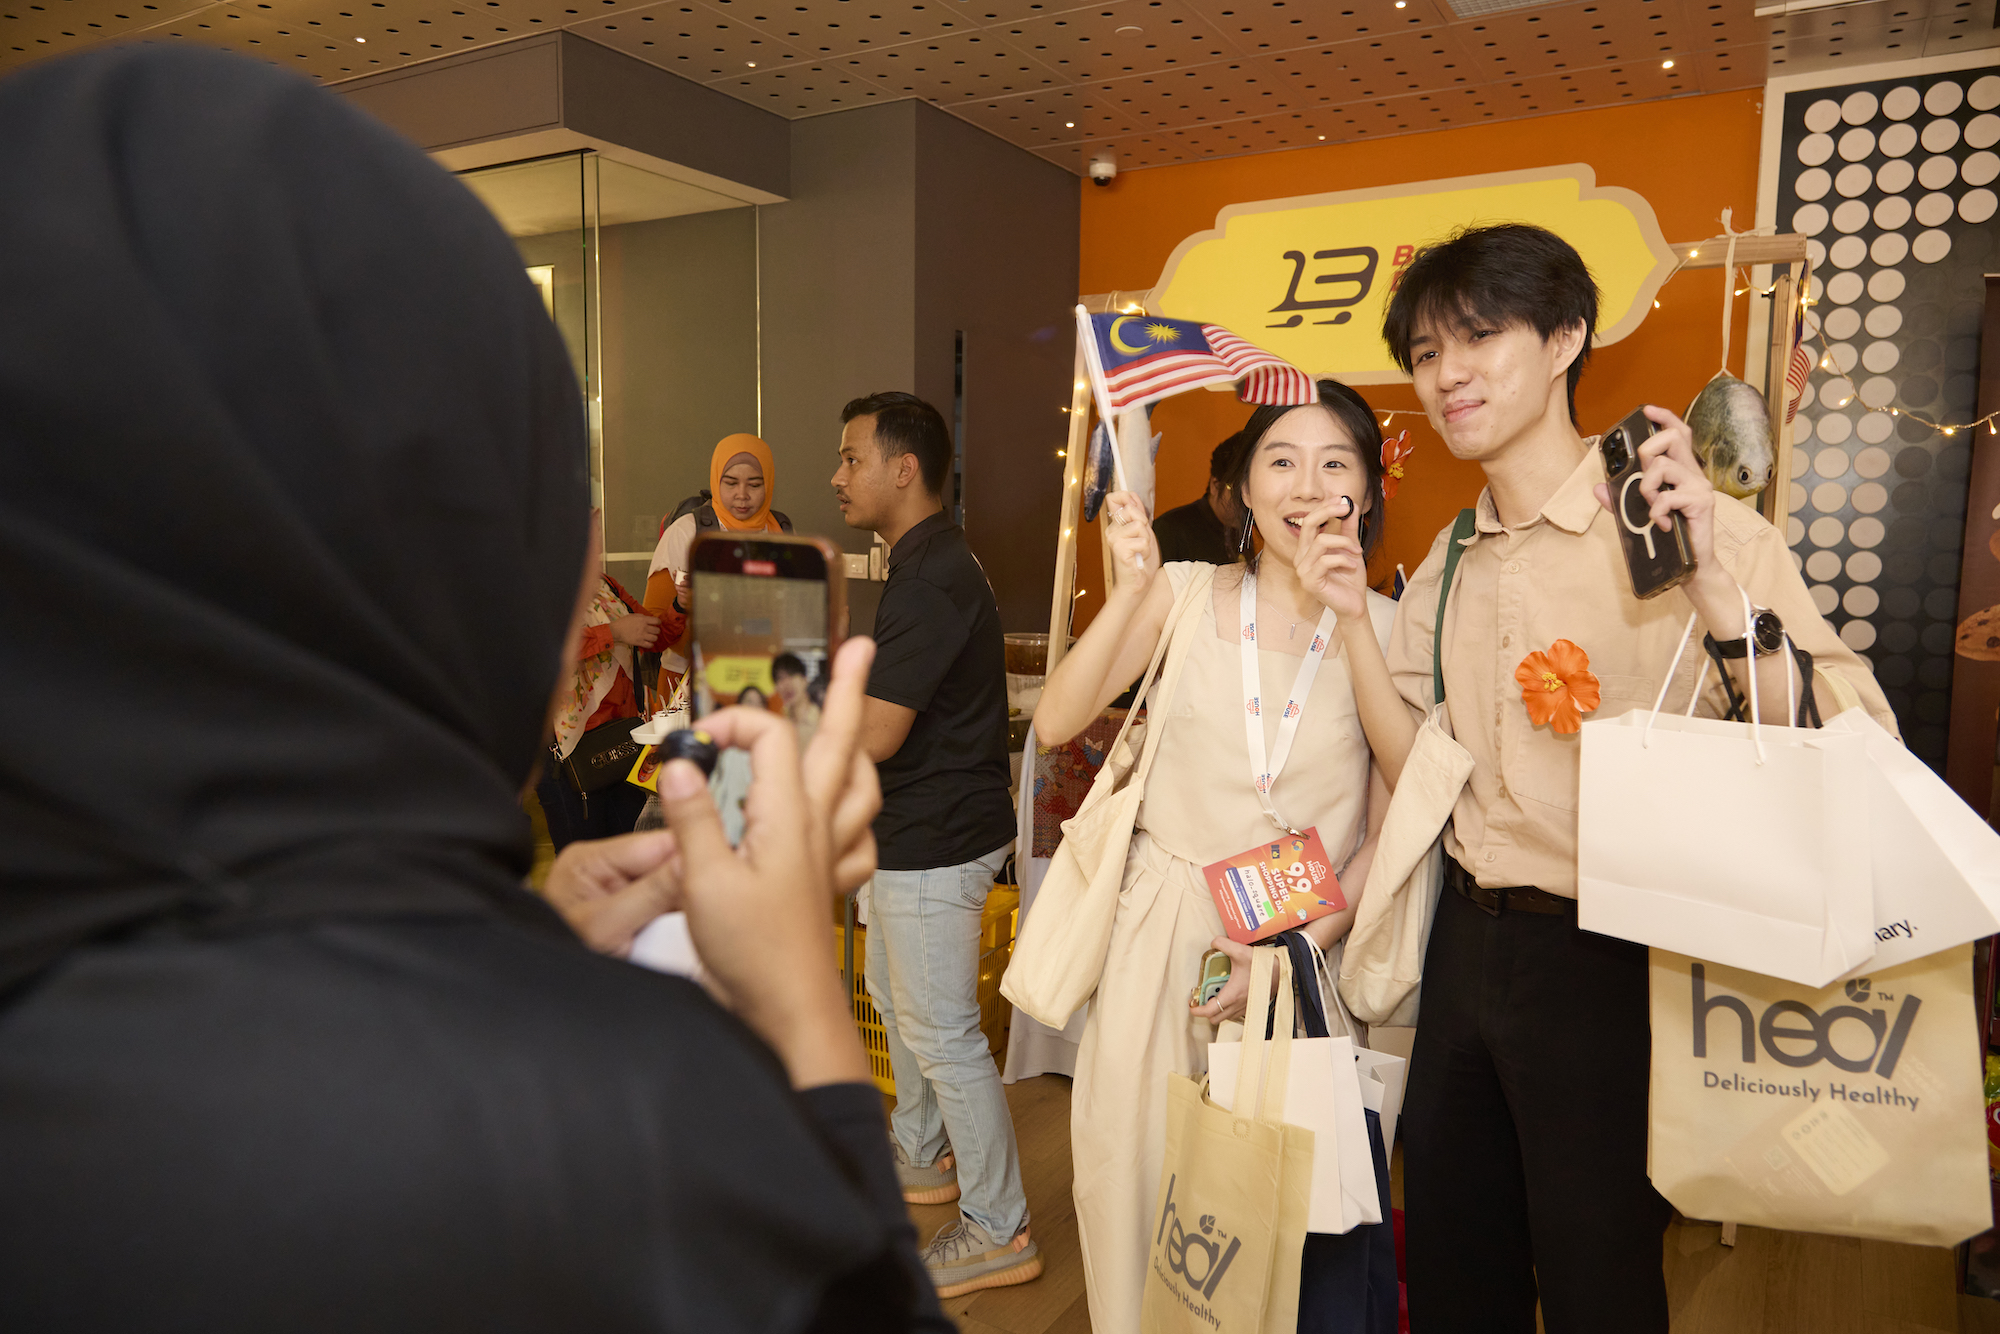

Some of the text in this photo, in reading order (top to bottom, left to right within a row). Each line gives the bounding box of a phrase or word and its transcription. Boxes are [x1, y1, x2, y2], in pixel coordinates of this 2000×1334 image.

[1259, 861, 1286, 914] SHOPPING DAY
[1270, 868, 1291, 903] SUPER
[1283, 861, 1312, 893] 9.9
[1306, 860, 1321, 885] HOUSE
[1691, 963, 1922, 1080] heal
[1703, 1071, 1920, 1112] Deliciously Healthy
[1157, 1173, 1242, 1302] heal
[1182, 1291, 1222, 1332] Healthy
